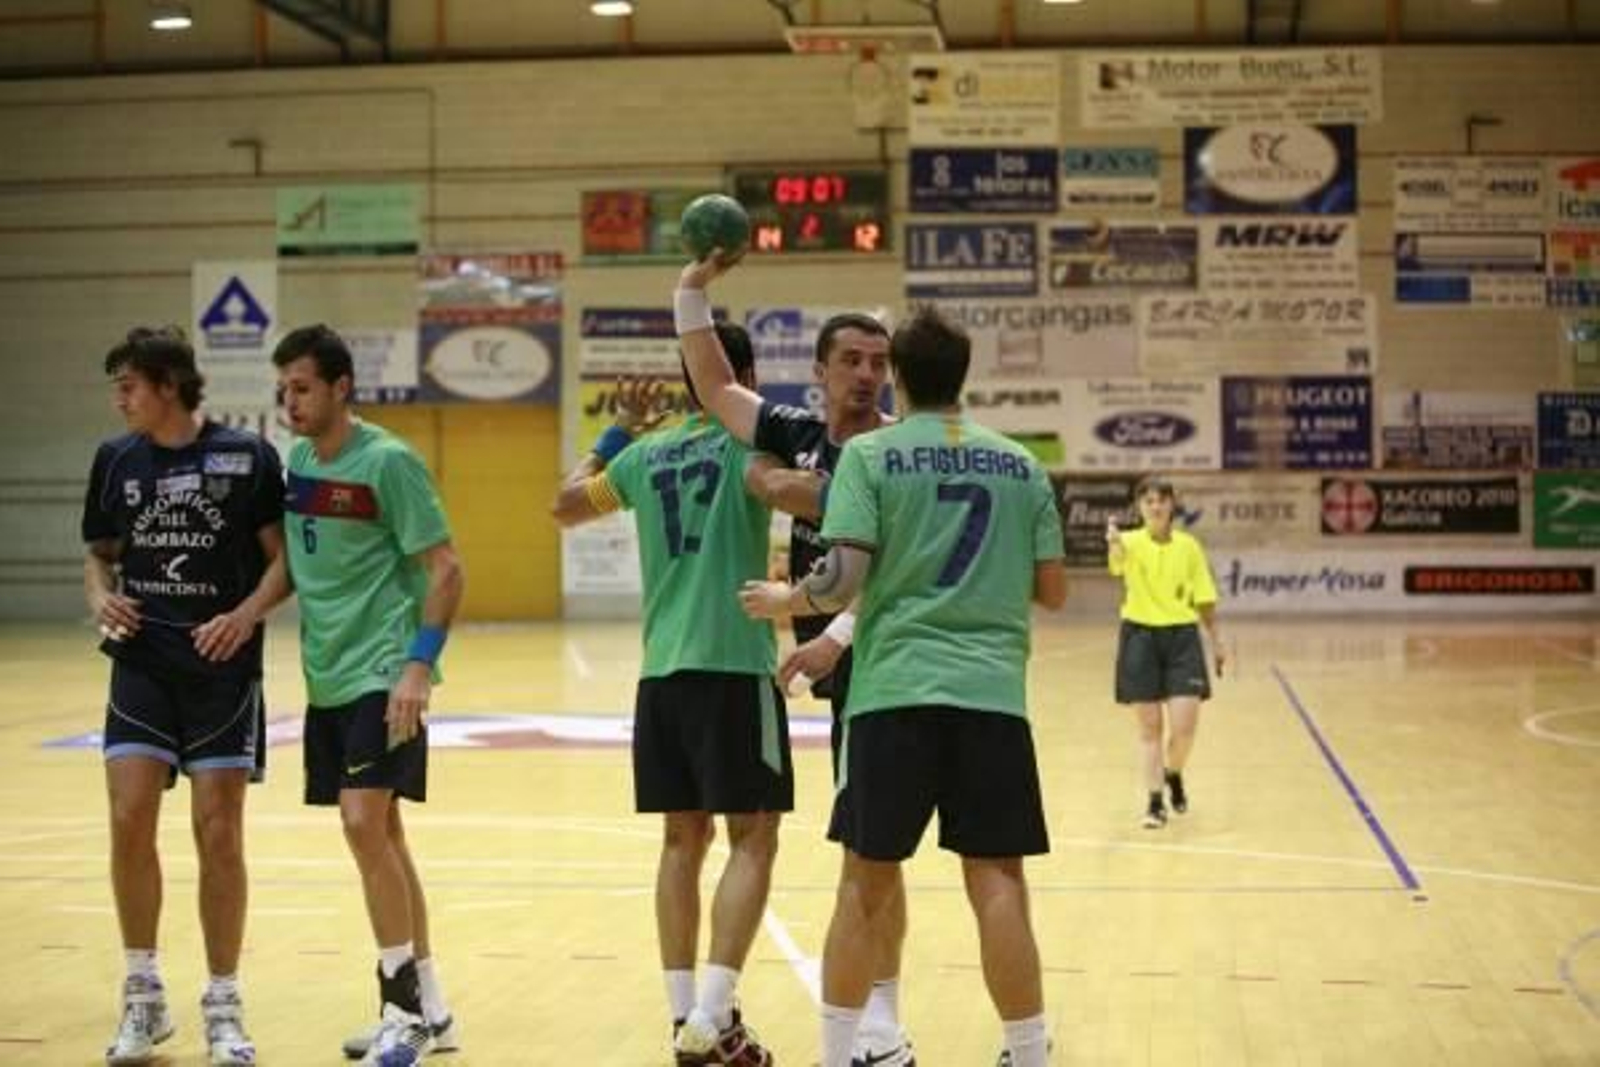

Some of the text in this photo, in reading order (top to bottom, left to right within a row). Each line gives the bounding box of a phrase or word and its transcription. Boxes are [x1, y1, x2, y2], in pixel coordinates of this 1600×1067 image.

[1149, 57, 1222, 80] Motor
[1214, 222, 1349, 248] MRW
[1252, 385, 1368, 404] PEUGEOT
[1111, 416, 1176, 444] Ford
[124, 479, 142, 506] 5
[1381, 487, 1473, 507] XACOBEO
[302, 518, 318, 555] 6
[936, 483, 992, 588] 7
